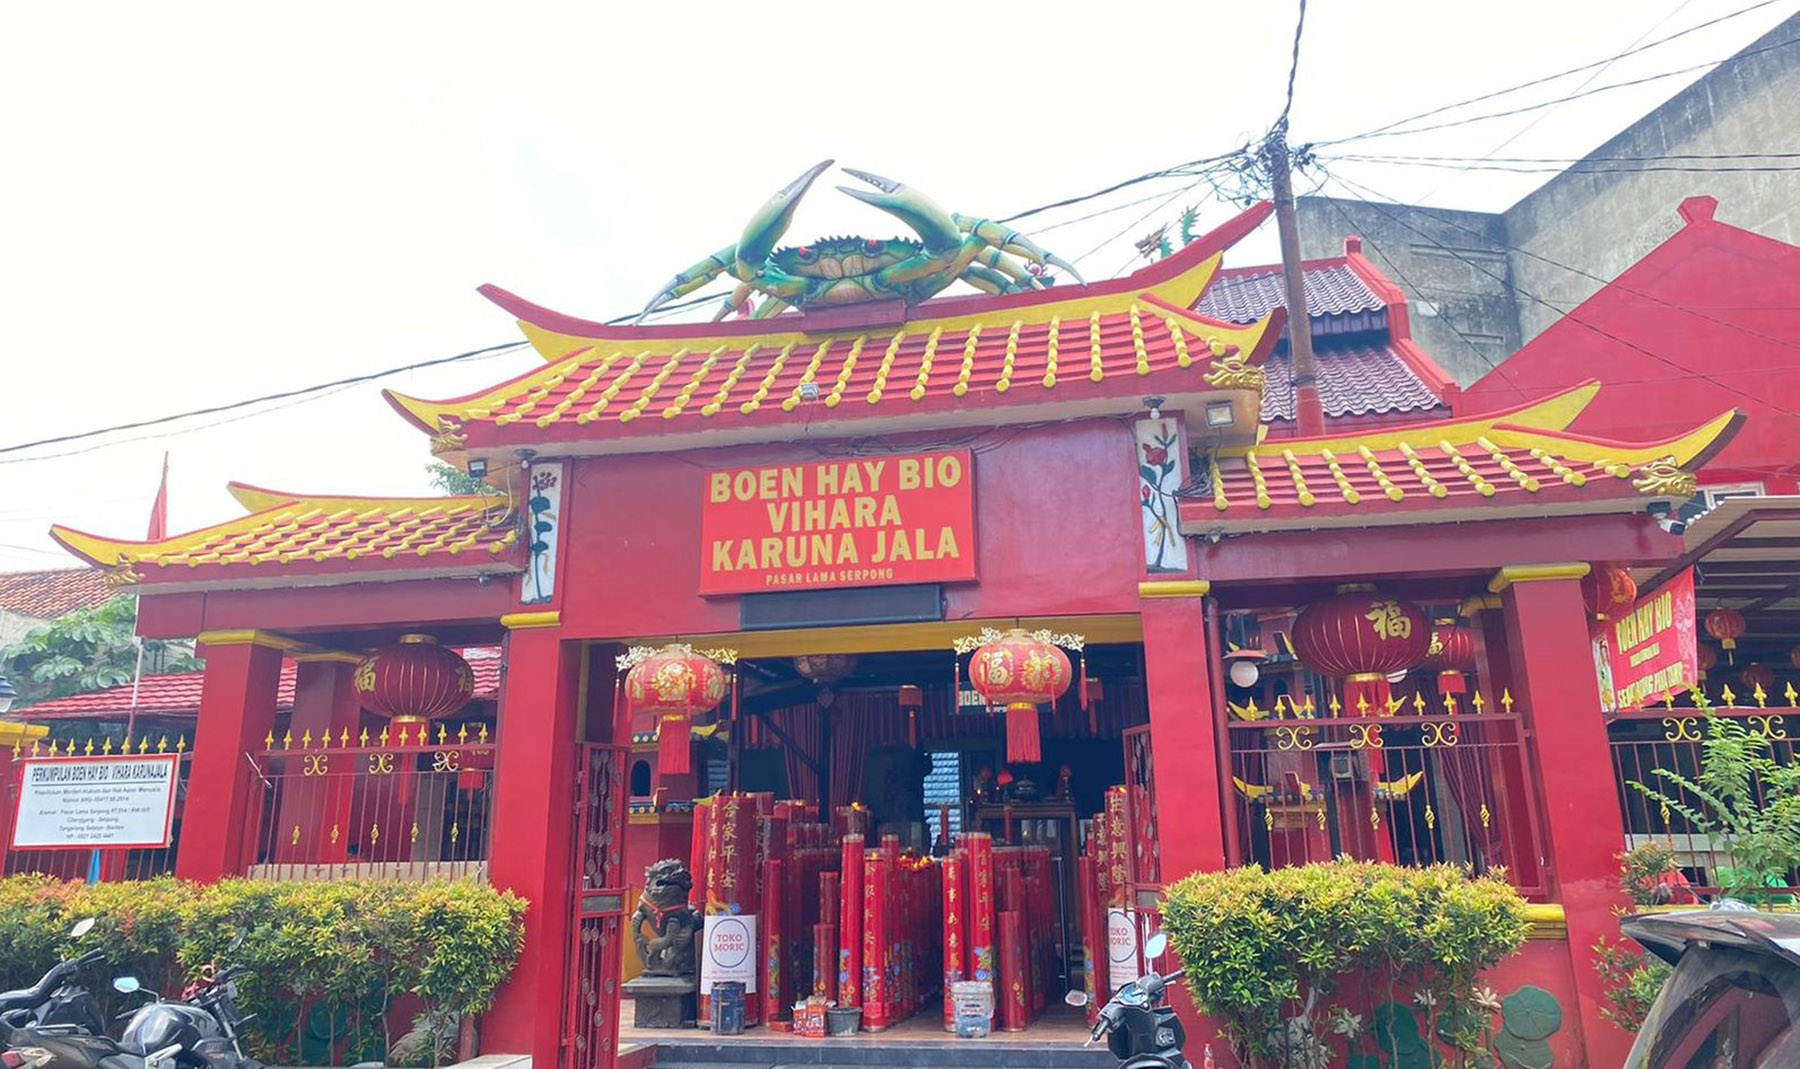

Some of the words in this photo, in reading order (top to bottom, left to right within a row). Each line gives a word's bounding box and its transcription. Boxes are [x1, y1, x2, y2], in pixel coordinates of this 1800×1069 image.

[711, 467, 803, 503] BOEN
[817, 461, 885, 496] HAY
[899, 456, 962, 490] BIO
[767, 495, 902, 533] VIHARA
[712, 533, 858, 571] KARUNA
[871, 527, 959, 563] JALA
[766, 573, 802, 586] PASAR
[806, 571, 836, 583] LAMA
[840, 568, 893, 581] SERPONG
[1365, 601, 1412, 641] 福
[1654, 591, 1672, 633] BIO
[354, 655, 380, 694] 福
[32, 767, 71, 782] PERKUMPULAN
[72, 766, 86, 781] BOEN
[87, 766, 99, 780] HAY
[98, 765, 109, 780] BIO
[111, 765, 132, 780] VIHARA
[721, 800, 739, 888] 合家平安
[714, 943, 745, 952] MORIC
[717, 934, 743, 942] TOKO
